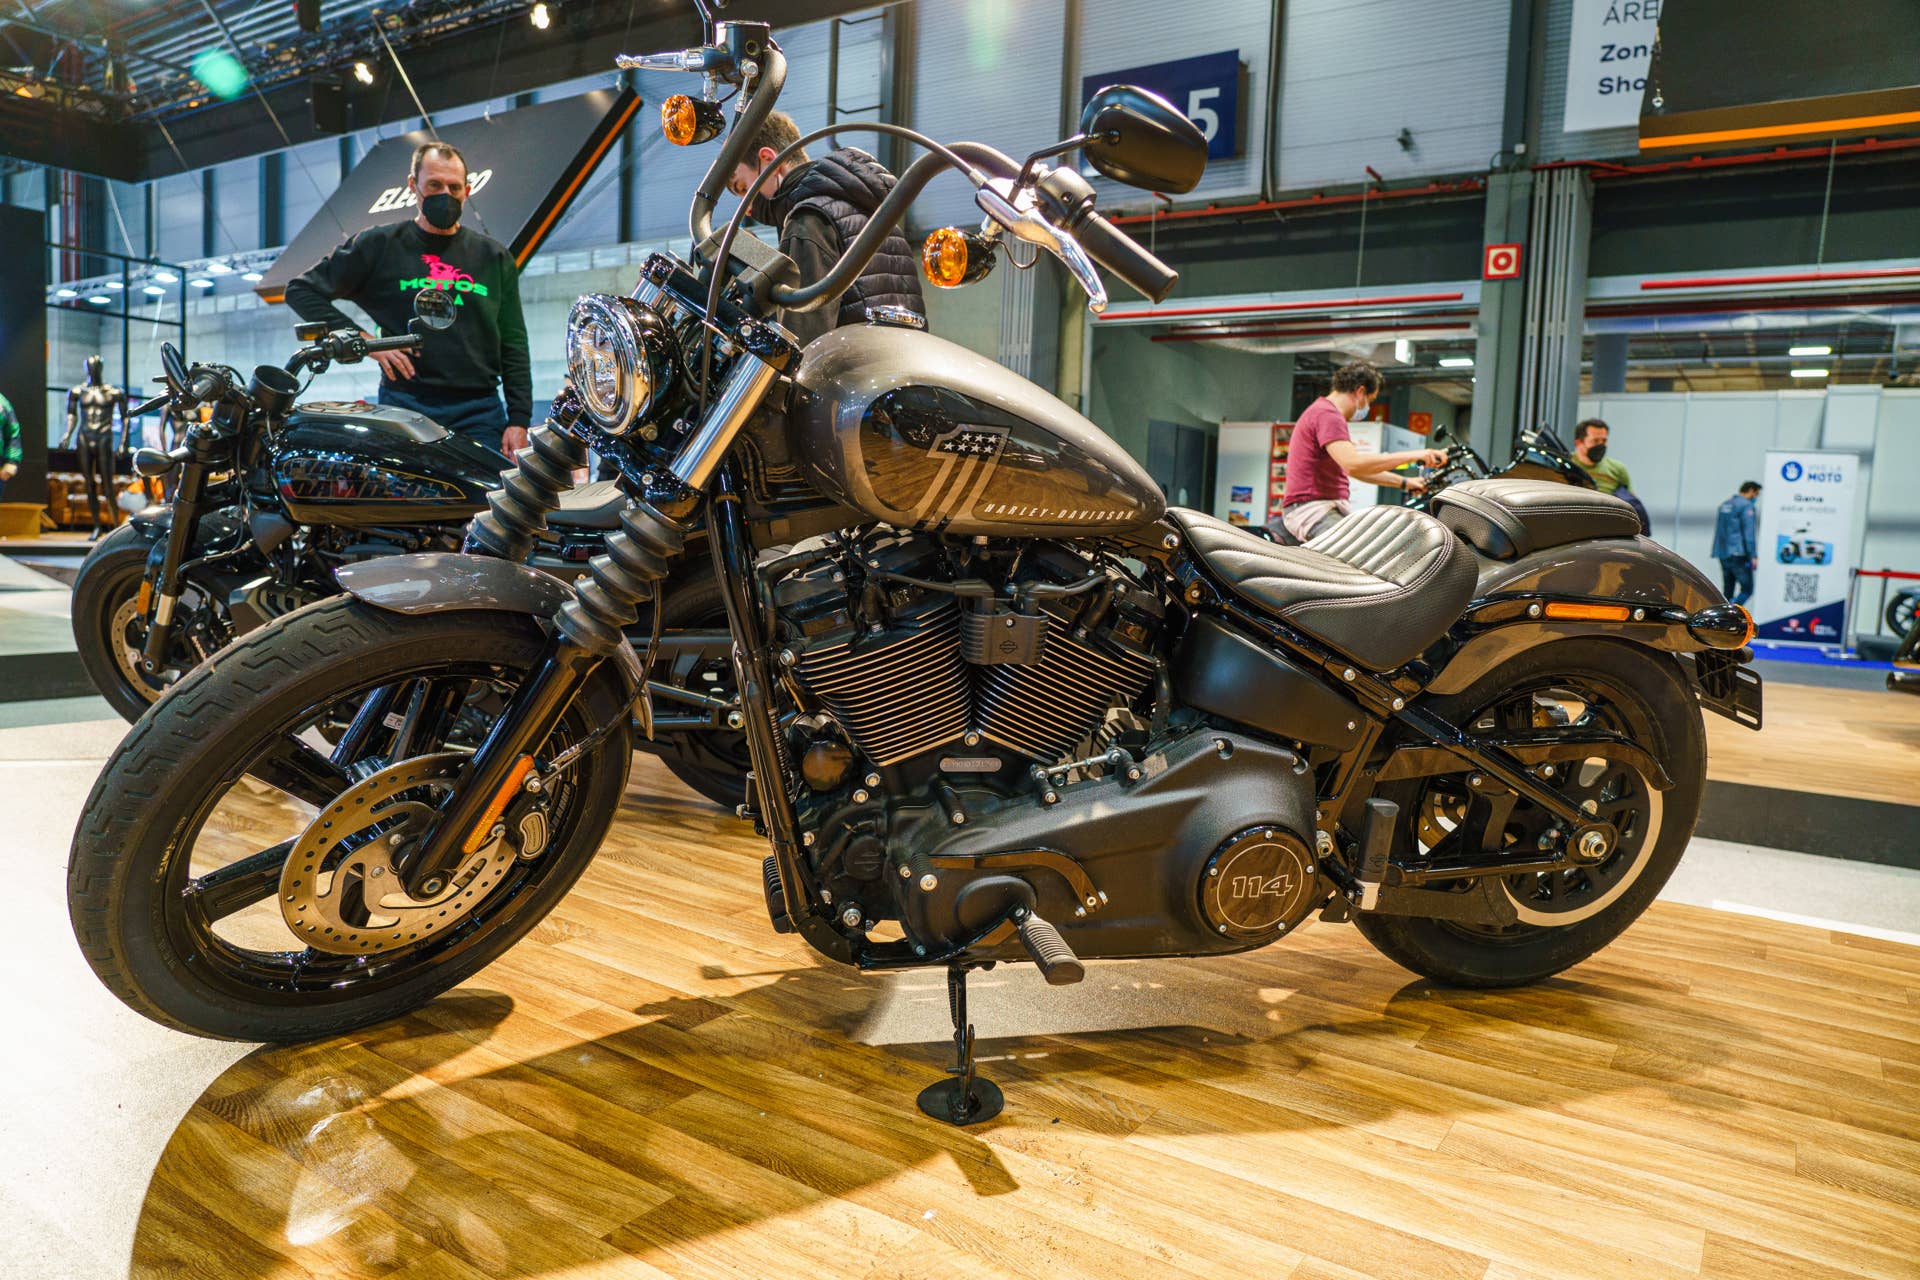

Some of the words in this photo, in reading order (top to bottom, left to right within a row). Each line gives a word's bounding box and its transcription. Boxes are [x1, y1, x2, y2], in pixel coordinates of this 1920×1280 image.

[1602, 0, 1659, 26] ÁRE
[1600, 44, 1654, 62] Zon
[1598, 76, 1647, 95] Sho
[1187, 86, 1220, 144] 5
[400, 278, 488, 297] MOTOS
[1807, 472, 1843, 483] MOTO
[984, 503, 1135, 521] HARLEY-DAVIDSON
[1232, 874, 1294, 898] 114
